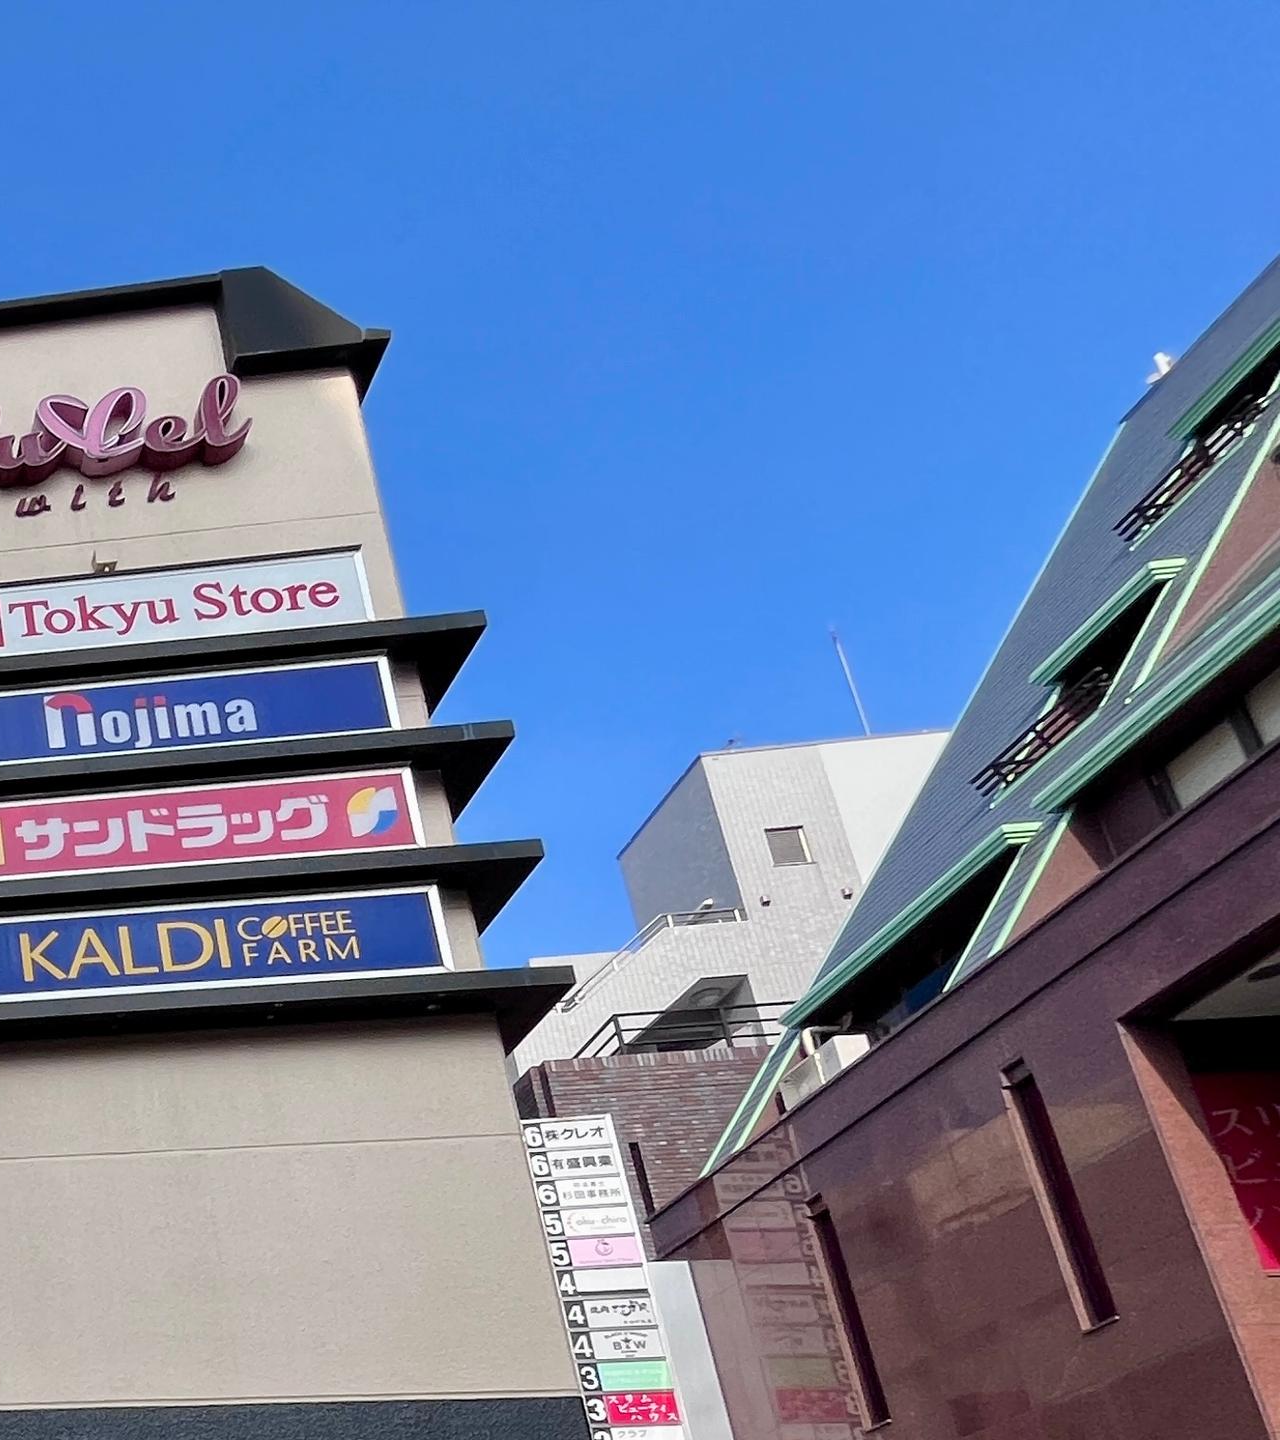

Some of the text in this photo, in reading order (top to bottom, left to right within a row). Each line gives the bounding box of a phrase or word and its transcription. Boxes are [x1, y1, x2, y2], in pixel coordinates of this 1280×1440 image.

[15, 472, 176, 518] with
[8, 578, 340, 640] Tokyu Store
[15, 794, 329, 862] サンドラッグ
[18, 909, 353, 982] KALDI COFFEE
[242, 936, 361, 967] FARM
[524, 1126, 543, 1147] 6
[531, 1154, 550, 1176] 6
[538, 1184, 557, 1205] 6
[543, 1213, 563, 1235] 5
[550, 1241, 571, 1266] 5
[559, 1273, 576, 1295] 4
[567, 1304, 585, 1325] 4
[573, 1334, 594, 1358] 4
[580, 1366, 599, 1390] 3
[586, 1398, 607, 1421] 3
